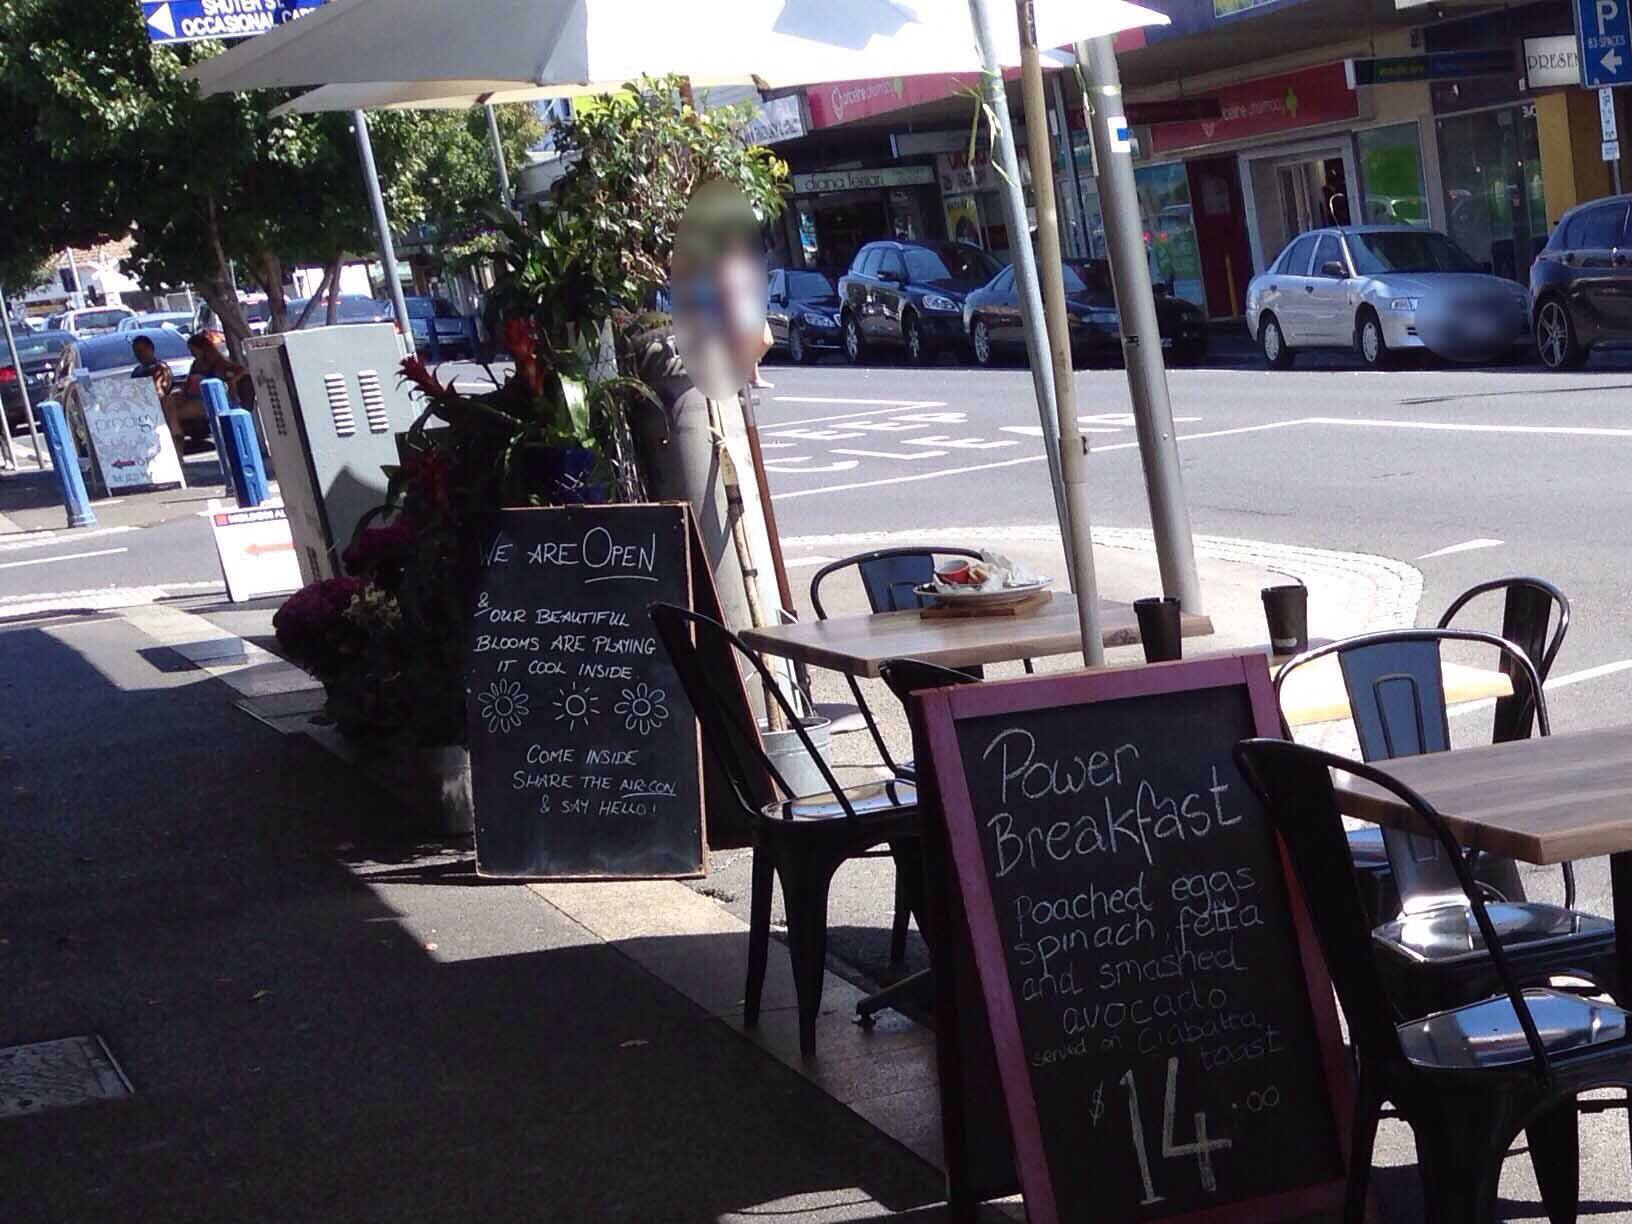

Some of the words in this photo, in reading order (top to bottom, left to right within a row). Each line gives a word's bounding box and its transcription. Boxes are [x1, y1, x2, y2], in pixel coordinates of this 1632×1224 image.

[181, 12, 279, 37] OCCASIONAL
[1595, 0, 1618, 34] P
[527, 542, 580, 566] ARE
[582, 526, 656, 573] OPEN
[489, 608, 527, 623] OUR
[535, 607, 631, 628] BEAUTIFUL
[473, 634, 540, 652] BLOOMS
[551, 634, 587, 653] ARE
[592, 635, 657, 655] PLAYING
[497, 659, 518, 674] IT
[528, 659, 567, 675] COOL
[526, 744, 575, 764] COME
[585, 749, 640, 766] INSIDE
[983, 728, 1140, 803] Power
[512, 770, 574, 790] SHARE
[579, 775, 613, 790] THE
[540, 794, 551, 814] &
[561, 799, 590, 815] SAY
[987, 765, 1243, 878] Breakfast
[1022, 961, 1084, 1000] and
[1099, 937, 1249, 989] smashed
[1063, 981, 1228, 1035] avocado
